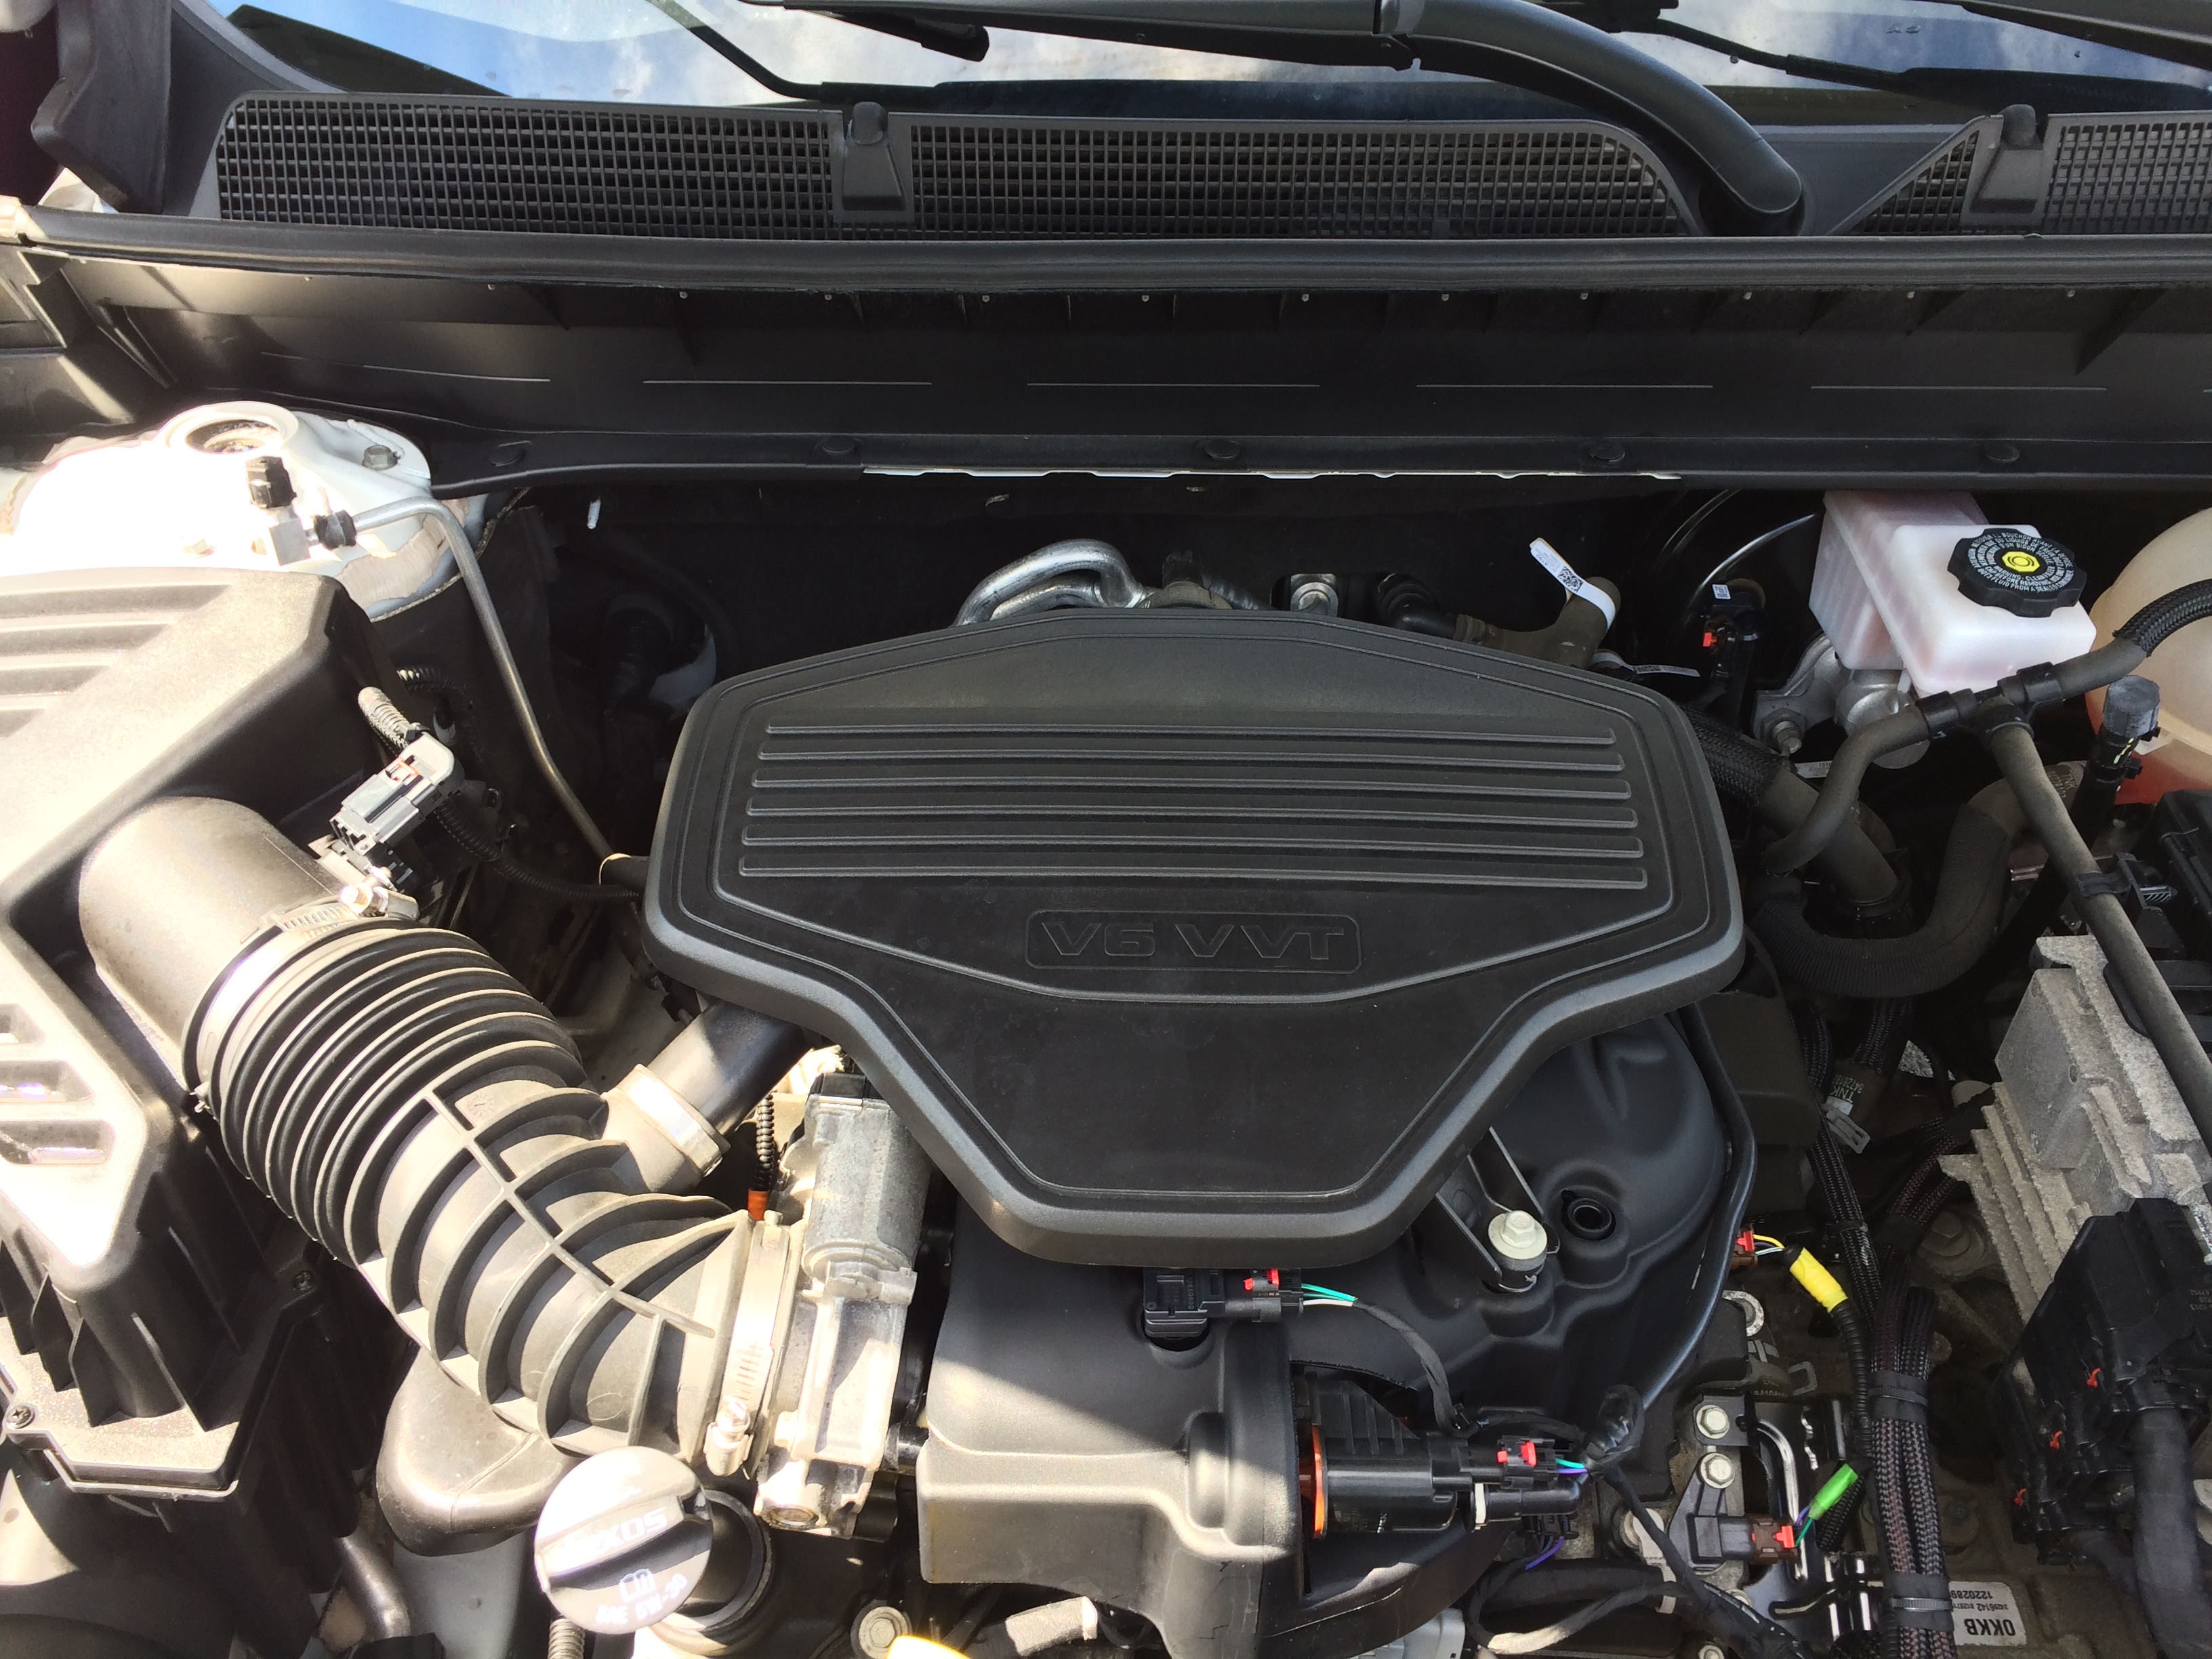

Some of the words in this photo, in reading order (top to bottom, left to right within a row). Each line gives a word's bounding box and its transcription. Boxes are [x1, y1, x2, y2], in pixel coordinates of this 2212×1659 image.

[1042, 922, 1155, 957] V6
[1174, 923, 1345, 961] VVT
[1830, 1086, 1854, 1103] TNK
[596, 1603, 629, 1624] SAE
[635, 1572, 688, 1620] 5W-30
